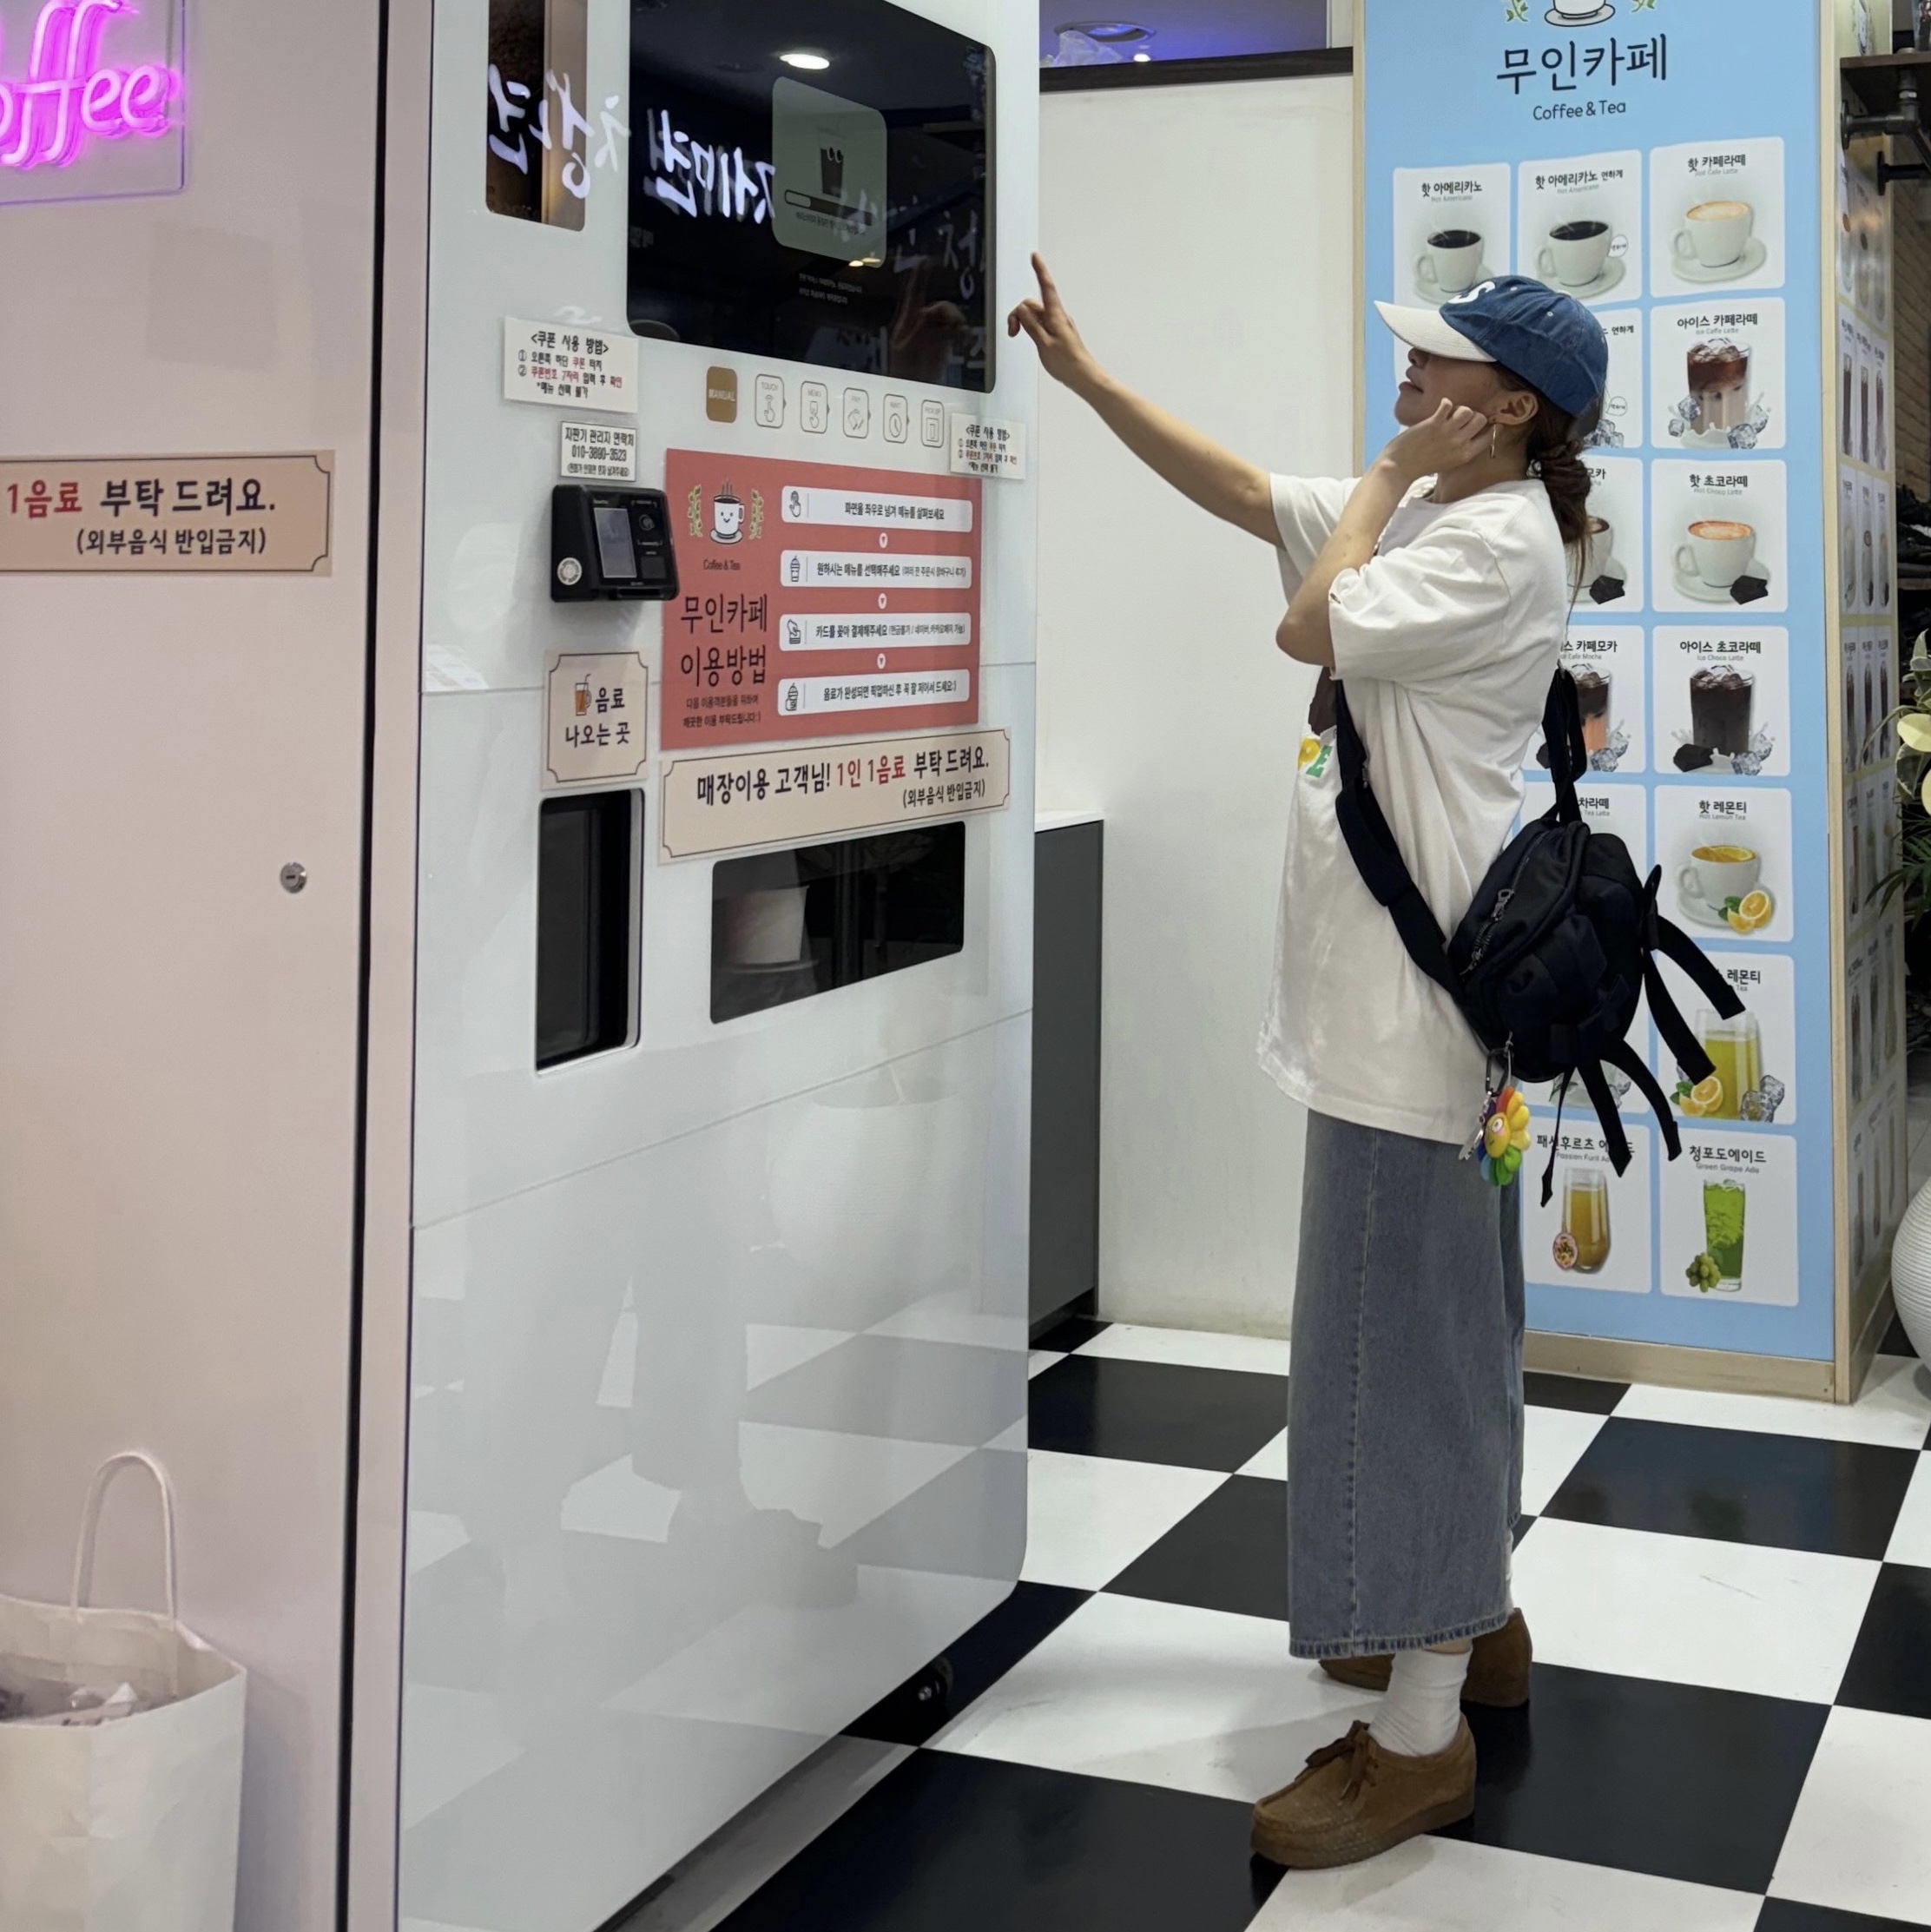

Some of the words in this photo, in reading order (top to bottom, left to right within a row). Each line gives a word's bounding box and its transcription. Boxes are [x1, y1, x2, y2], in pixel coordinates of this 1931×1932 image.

[1497, 33, 1666, 95] 무인카페
[1532, 103, 1584, 121] Coffee
[1598, 100, 1626, 115] Tea
[1687, 157, 1698, 173] 핫
[1702, 154, 1746, 168] 카페라떼
[1535, 175, 1545, 190] 핫
[1548, 169, 1598, 188] 아메리카노
[1421, 182, 1431, 198] 핫
[1433, 181, 1482, 195] 아메리카노
[1611, 325, 1634, 335] 연하게
[1677, 314, 1710, 330] 아이스
[1713, 313, 1758, 327] 카페라떼
[562, 335, 579, 352] 사용
[1587, 468, 1606, 479] 모카
[1689, 473, 1701, 487] 핫
[1704, 475, 1748, 488] 초코라떼
[7, 479, 82, 519] 1음료
[100, 478, 164, 517] 부탁
[172, 478, 275, 517] 드려요.
[76, 528, 168, 555] (외부음식
[175, 527, 267, 555] 반입금지)
[817, 563, 843, 577] 원하시는
[681, 593, 768, 634] 무인카페
[815, 624, 835, 638] 카드를
[1576, 640, 1618, 652] 카페모카
[1680, 641, 1713, 653] 아이스
[1716, 641, 1761, 654] 초코라떼
[681, 644, 766, 687] 이용방법
[595, 687, 625, 714] 음료
[565, 723, 610, 748] 나오는
[616, 722, 630, 745] 곳
[697, 768, 770, 807] 매장이용
[774, 762, 831, 795] 고객님!
[837, 759, 861, 788] 1인
[868, 755, 906, 785] 1음료
[913, 749, 942, 779] 부탁
[946, 746, 989, 774] 드려요.
[903, 784, 945, 808] (외부음식
[946, 779, 985, 802] 반입금지)
[1578, 797, 1610, 810] 차라떼
[1698, 800, 1710, 814] 핫
[1713, 801, 1747, 814] 레몬티
[1727, 969, 1761, 985] 레몬티
[1689, 1145, 1767, 1164] 청포도에이드
